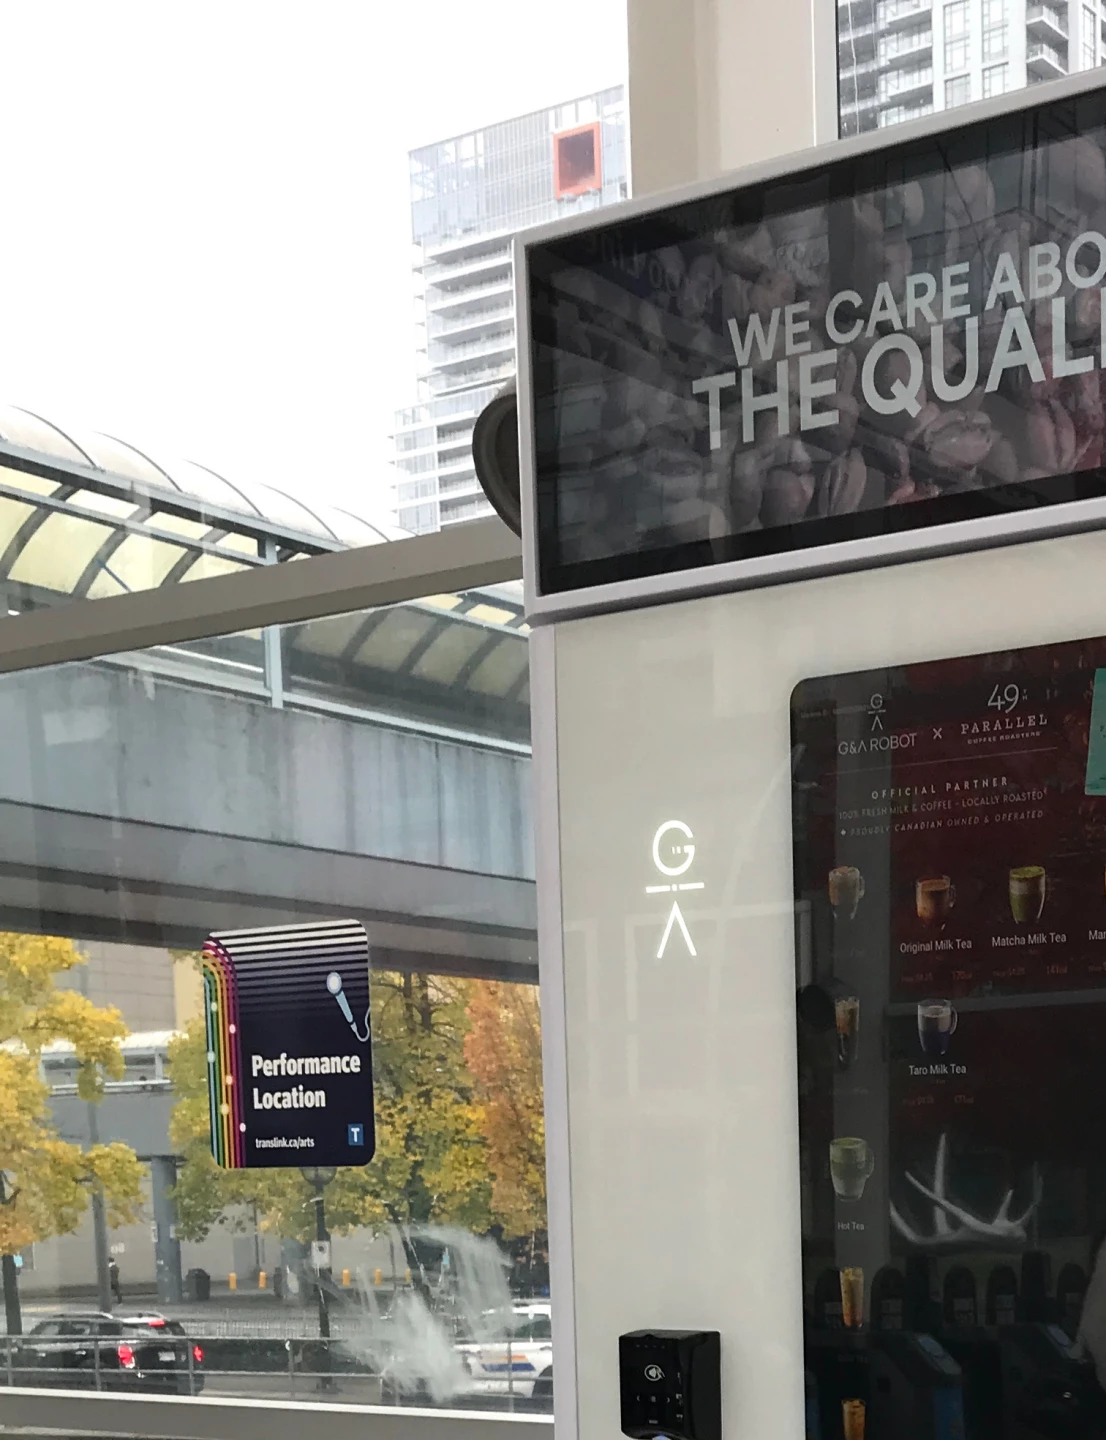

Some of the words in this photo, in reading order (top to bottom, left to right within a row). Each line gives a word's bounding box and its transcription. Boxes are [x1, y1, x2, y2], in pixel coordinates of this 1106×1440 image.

[728, 300, 811, 366] WE
[825, 262, 970, 344] CARE
[692, 348, 839, 450] THE
[961, 713, 1048, 735] PARALLEL
[870, 732, 917, 750] ROBOT
[872, 785, 936, 800] OFFICIAL
[945, 776, 1008, 792] PARTNER
[862, 806, 887, 818] FRESH
[889, 804, 909, 816] MILK
[920, 800, 952, 813] COFFEE
[962, 795, 1000, 808] LOCALLY
[1003, 790, 1044, 803] ROASTED
[895, 819, 943, 833] CANADIAN
[947, 815, 980, 827] OWNED
[994, 810, 1044, 822] OPERATED
[900, 942, 933, 955] Original
[934, 939, 954, 951] Milk
[955, 938, 972, 950] Tea
[992, 935, 1026, 948] Matcha
[1027, 932, 1047, 945] Milk
[1049, 932, 1067, 943] Tea
[251, 1052, 361, 1077] Performance
[908, 1064, 928, 1076] Taro
[930, 1063, 948, 1075] Milk
[949, 1063, 967, 1075] Tea
[253, 1084, 326, 1110] Location
[255, 1136, 315, 1149] translink.ca/arts
[351, 1127, 361, 1143] T
[837, 1221, 850, 1231] Hot
[851, 1221, 865, 1231] Tea
